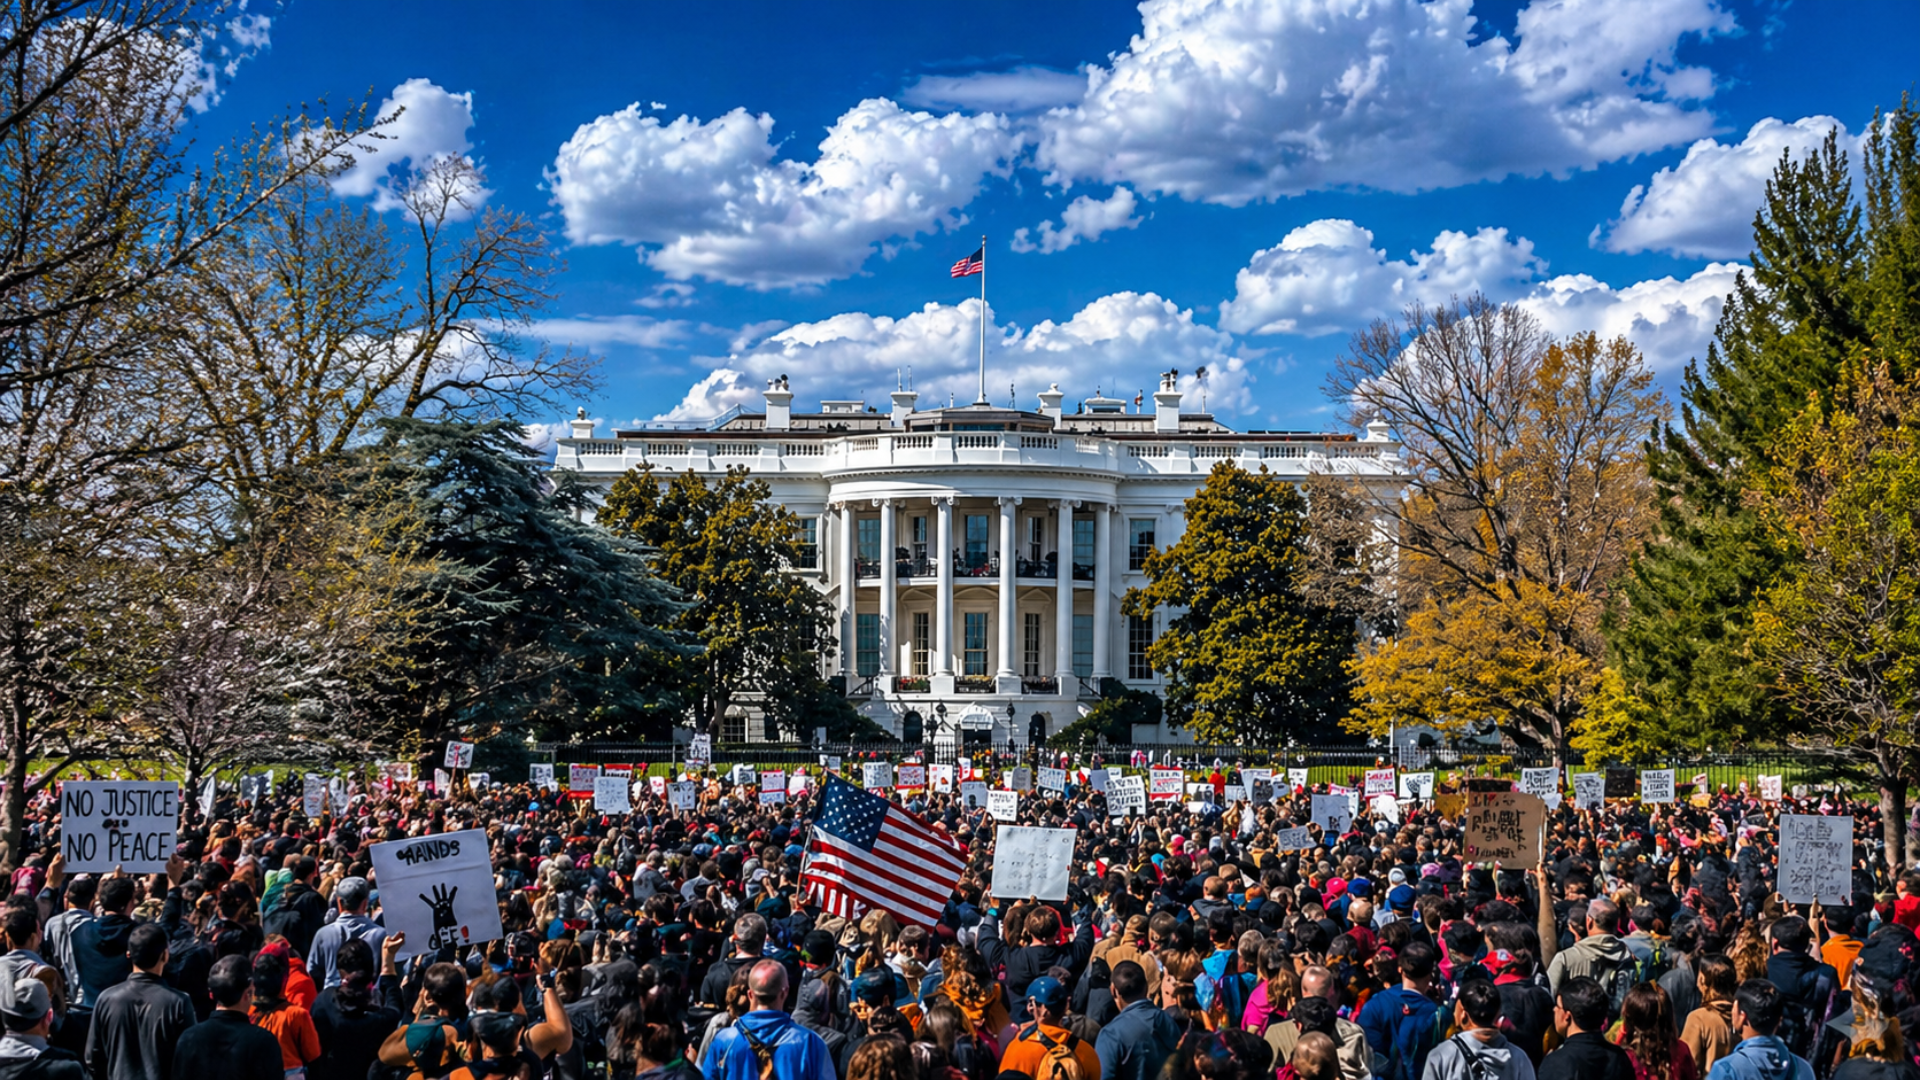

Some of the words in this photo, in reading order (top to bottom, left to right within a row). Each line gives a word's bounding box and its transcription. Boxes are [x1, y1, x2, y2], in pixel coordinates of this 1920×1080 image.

[65, 789, 94, 817] NO
[101, 789, 174, 817] JUSTICE
[67, 832, 97, 863] NO
[108, 829, 171, 862] PEACE
